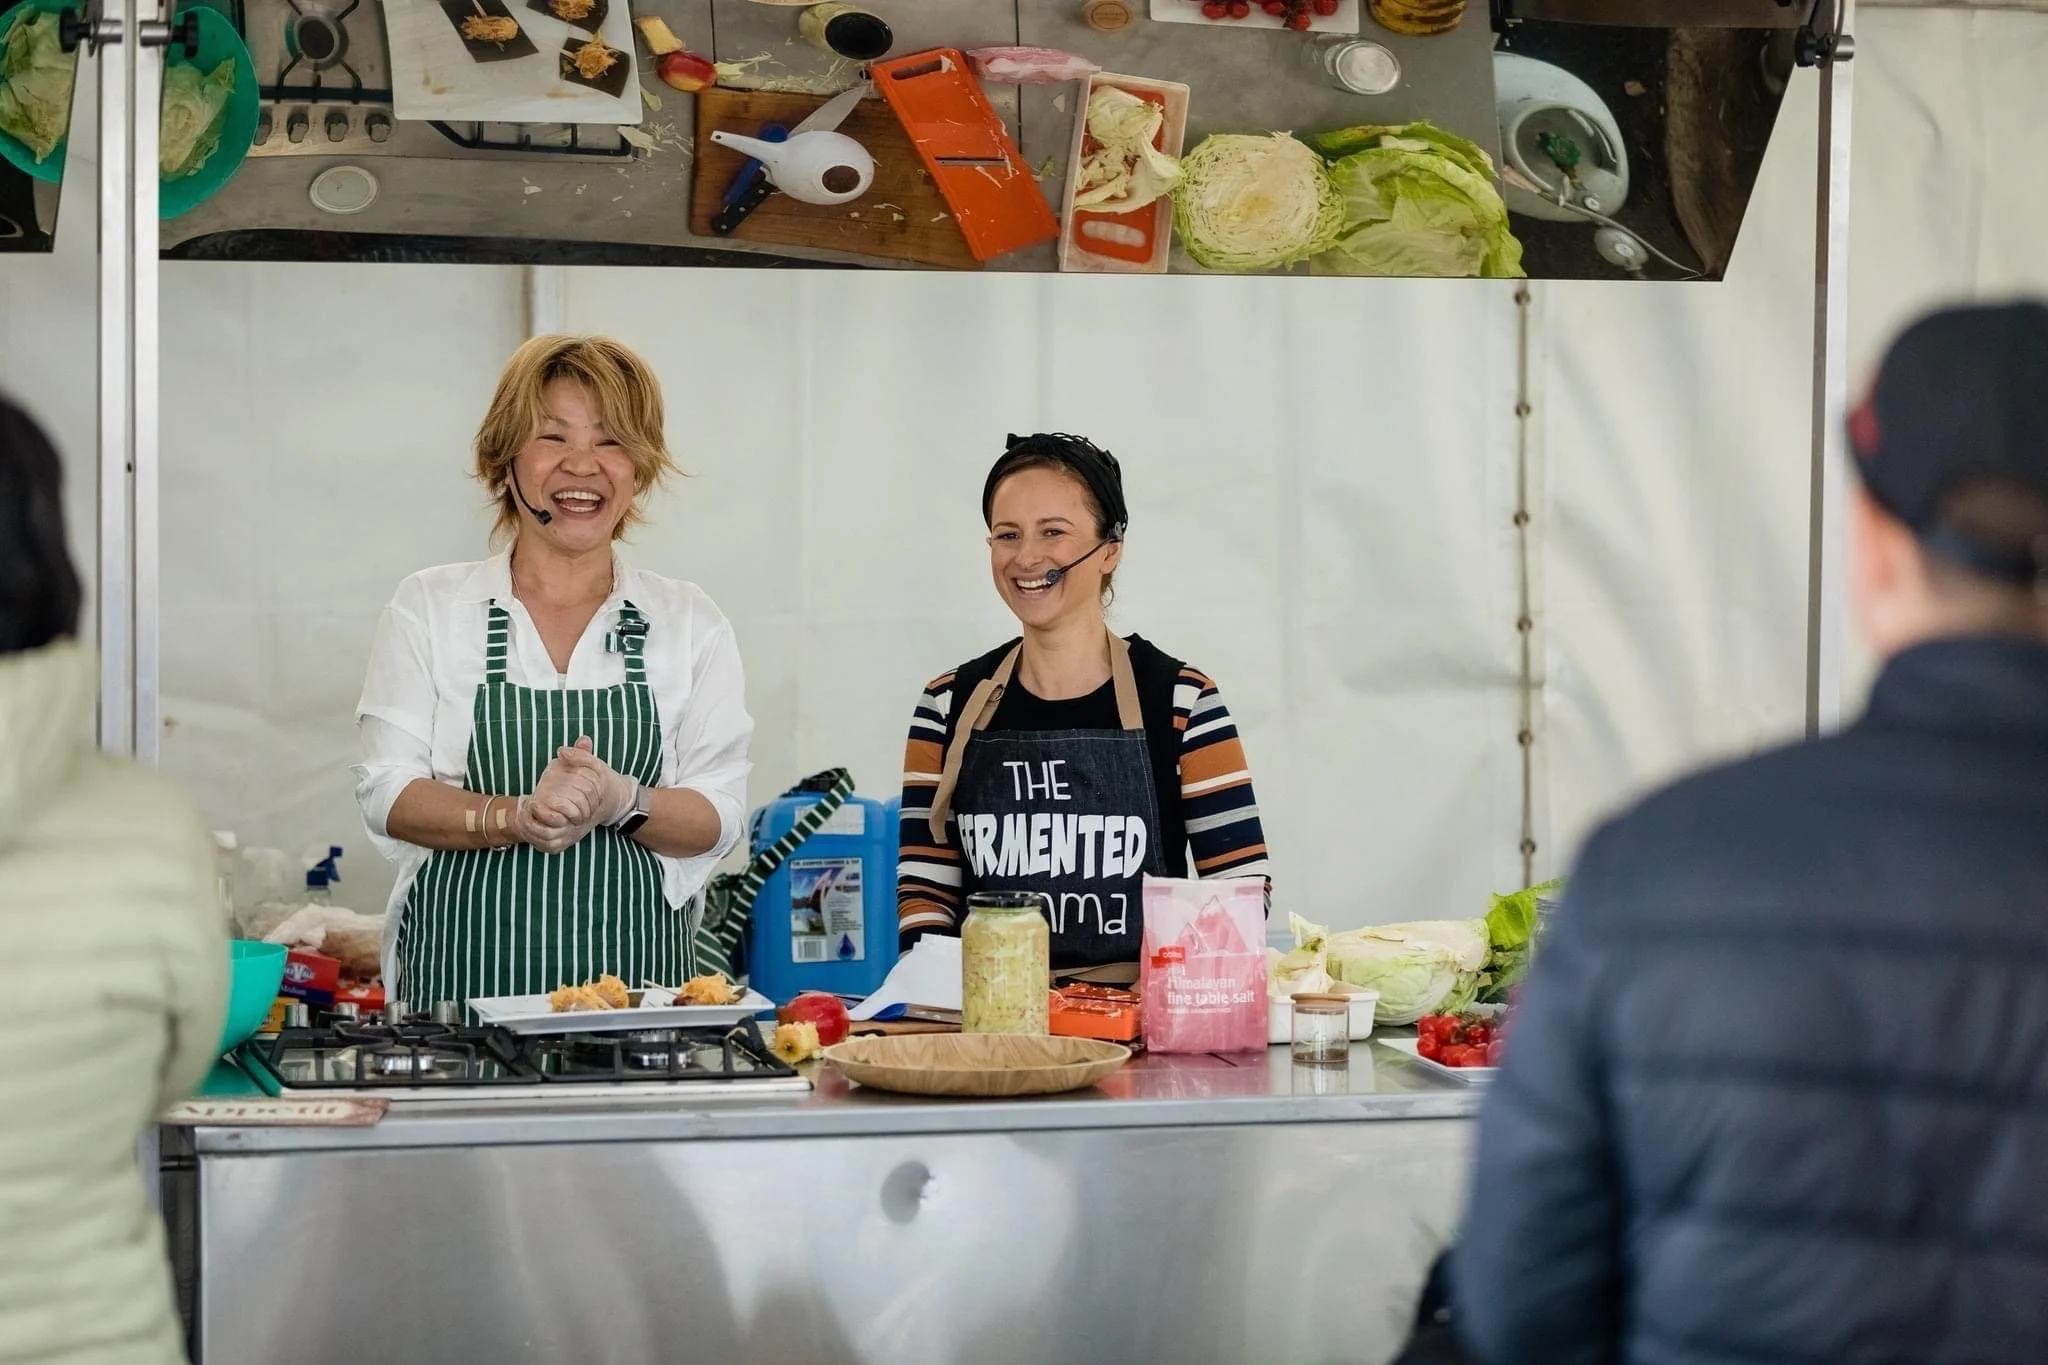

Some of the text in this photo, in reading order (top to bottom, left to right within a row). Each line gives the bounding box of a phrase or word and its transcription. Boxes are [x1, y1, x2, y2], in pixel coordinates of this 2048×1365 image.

[1002, 760, 1072, 801] THE
[957, 813, 1147, 880] FERMENTED
[1167, 976, 1236, 990] Himalayan
[1167, 989, 1255, 1006] fine table salt
